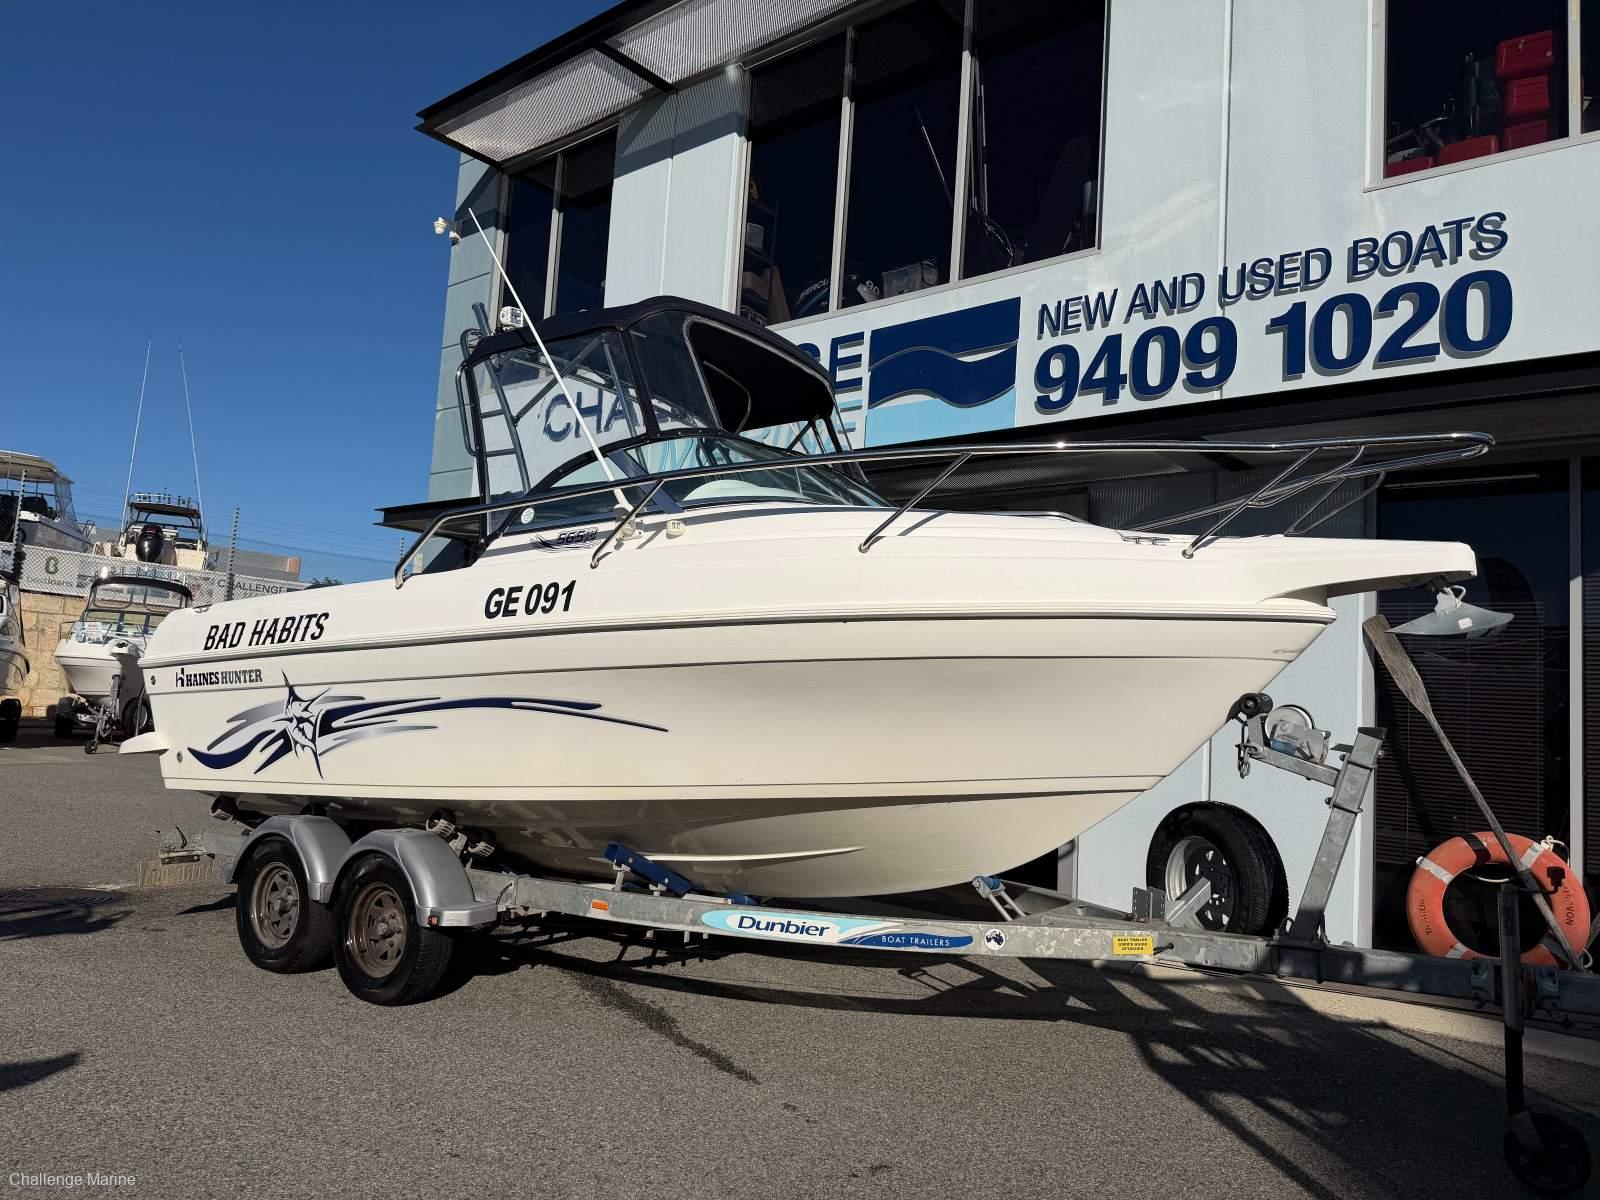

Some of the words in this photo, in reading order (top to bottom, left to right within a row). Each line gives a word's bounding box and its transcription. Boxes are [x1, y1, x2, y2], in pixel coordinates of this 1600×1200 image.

[1038, 288, 1118, 338] NEW
[1125, 272, 1206, 323] AND
[1219, 247, 1332, 301] USED
[1349, 211, 1509, 279] BOATS
[1034, 316, 1238, 414] 9409
[1264, 269, 1513, 381] 1020
[217, 580, 284, 594] CALLENGE
[484, 586, 524, 619] GE
[525, 580, 577, 615] 091
[203, 621, 246, 651] BAD
[248, 612, 330, 646] HABITS
[186, 671, 220, 687] HAINES
[220, 668, 263, 685] HUNTER
[737, 915, 830, 937] Dunbier
[881, 935, 905, 944] BOAT
[909, 936, 951, 947] TRAILERS
